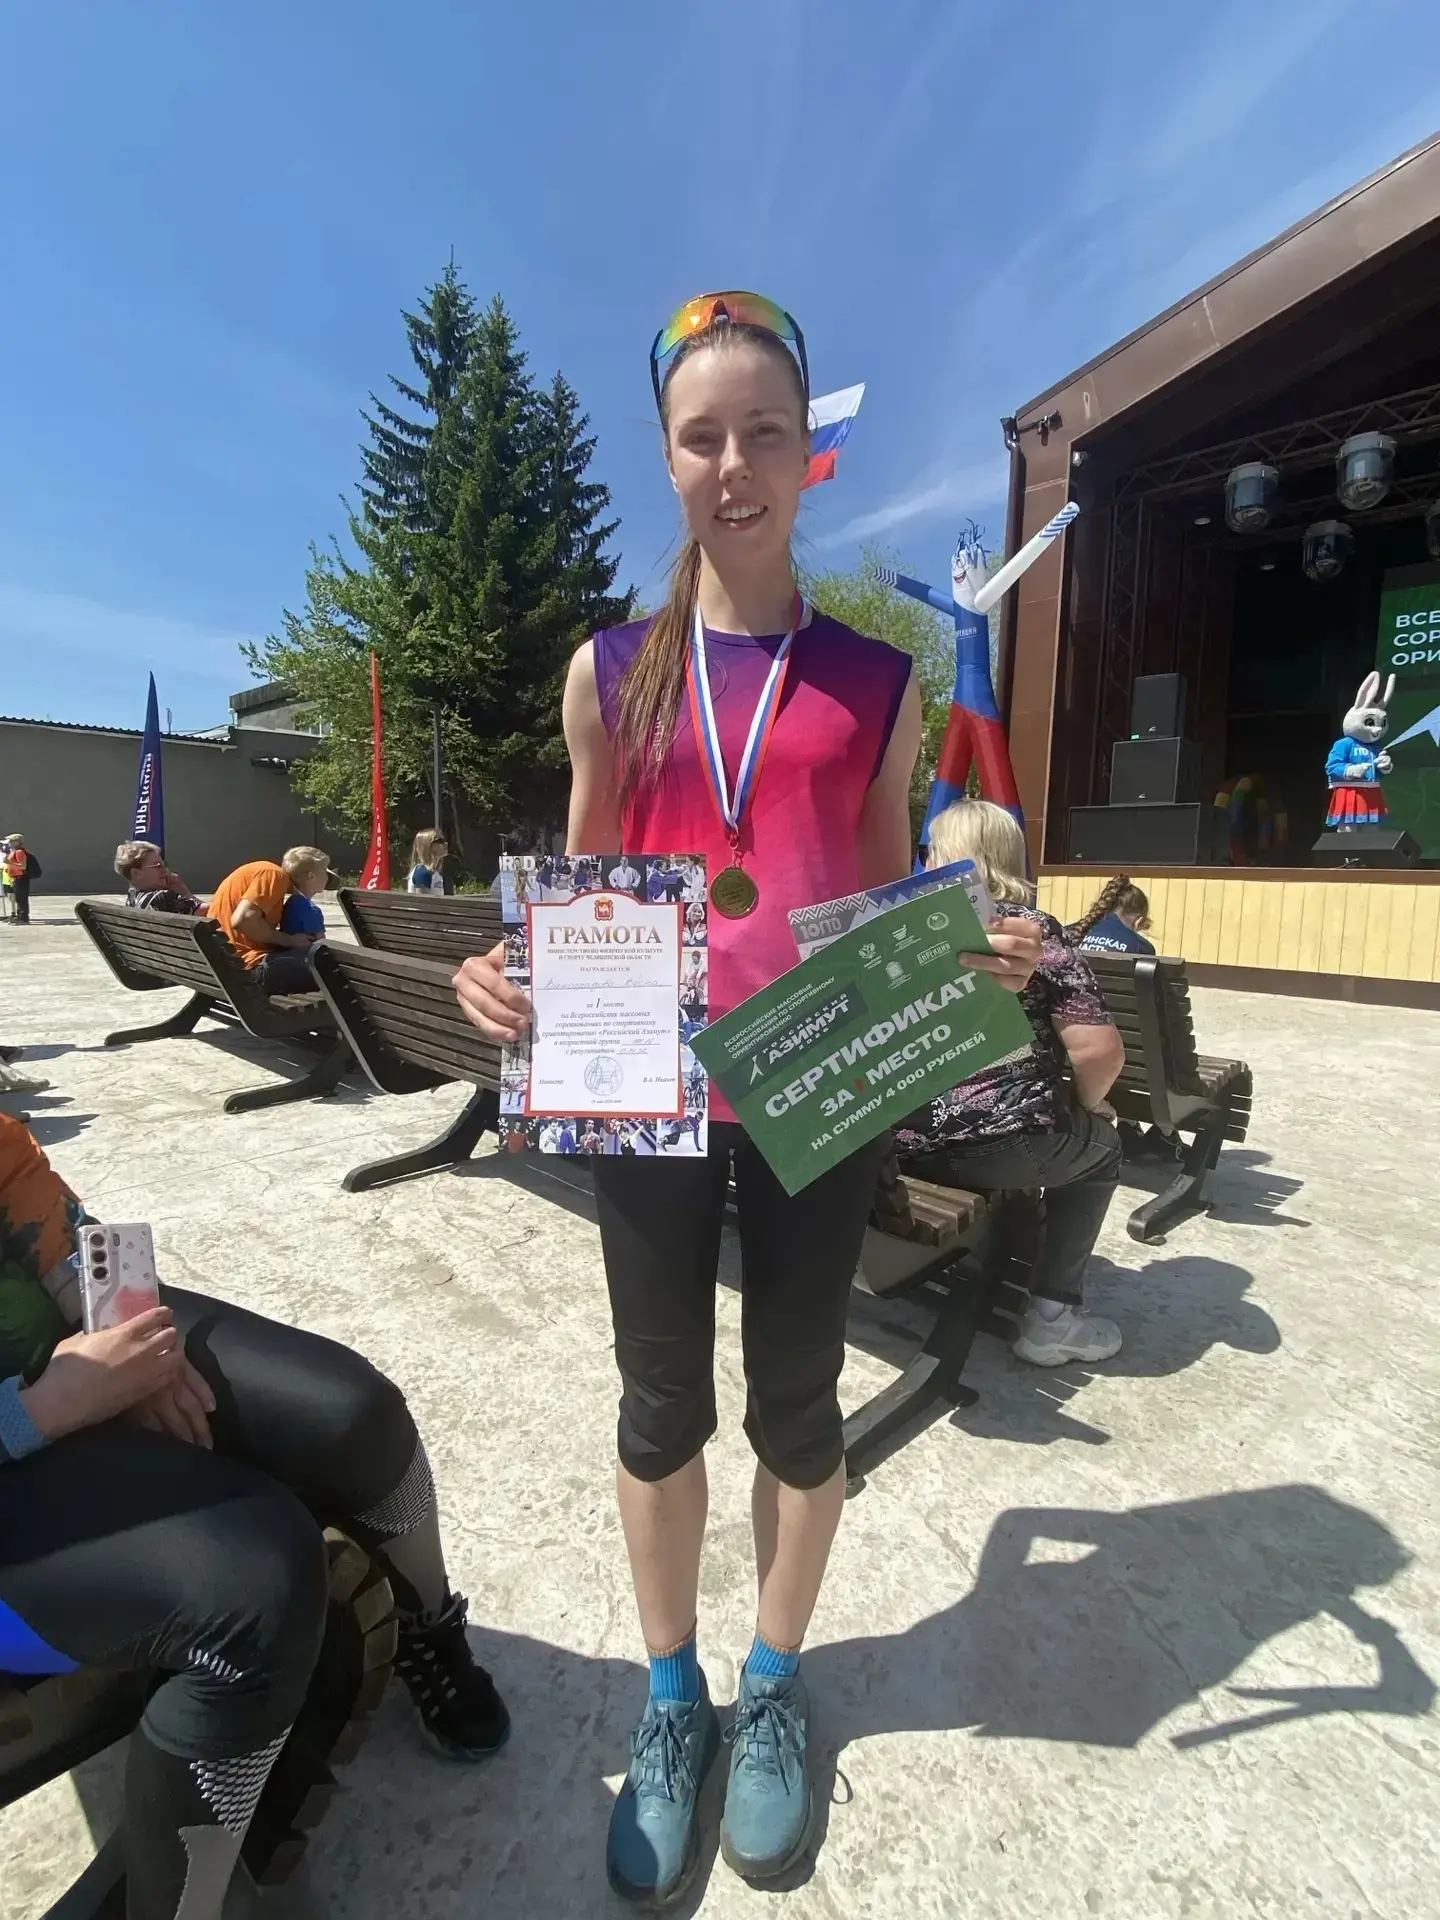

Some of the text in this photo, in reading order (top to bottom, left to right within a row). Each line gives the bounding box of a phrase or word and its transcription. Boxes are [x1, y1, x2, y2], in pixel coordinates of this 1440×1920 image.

[547, 925, 663, 944] ГРАМОТА
[918, 942, 951, 965] ДИРЕКЦИЯ
[1082, 935, 1128, 952] ИНСКАЯ
[570, 1010, 618, 1020] Всероссийских
[724, 983, 813, 1048] ВСЕРОССИЙСКИЕ МАССОВЫЕ
[728, 976, 835, 1053] СОРЕВНОВАНИЯ ПО СПОРТИВНОМУ
[731, 1014, 792, 1059] ОРИЕНТИРОВАНИЮ
[762, 993, 847, 1054] РОССИЙСКИЙ
[765, 971, 977, 1118] СЕРТИФИКАТ
[768, 999, 849, 1065] АЗИМУТ
[799, 1027, 829, 1051] 2026
[810, 1031, 987, 1151] НА СУММУ 4 000 РУБЛЕЙ
[820, 1088, 855, 1118] ЗА
[865, 1024, 952, 1086] МЕСТО
